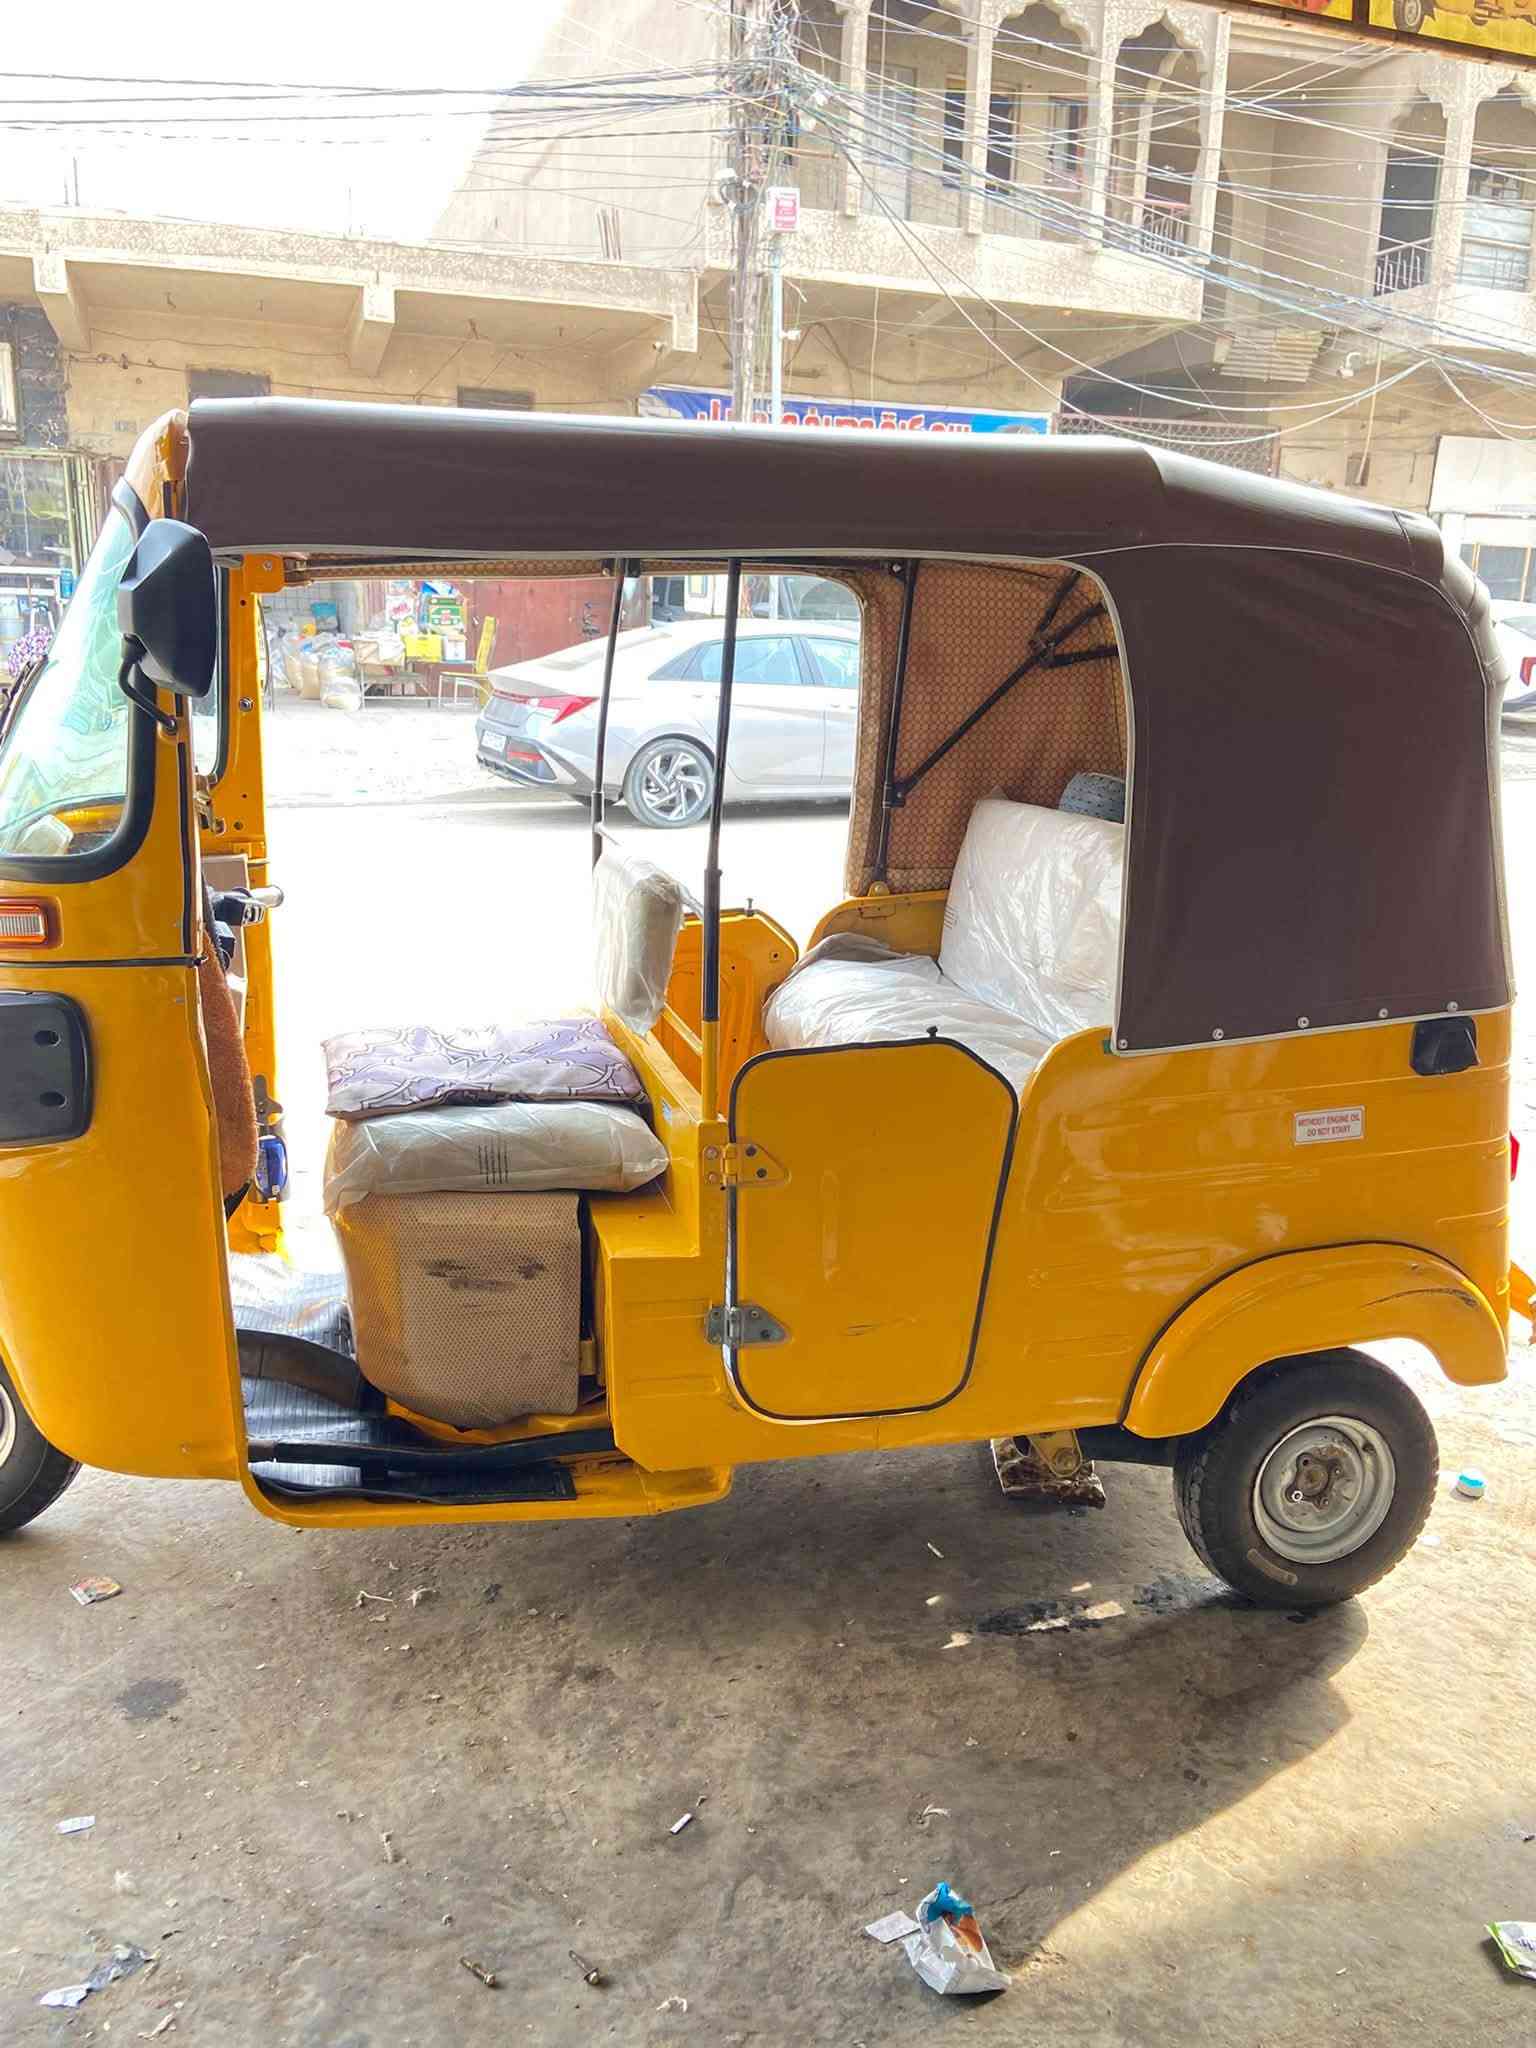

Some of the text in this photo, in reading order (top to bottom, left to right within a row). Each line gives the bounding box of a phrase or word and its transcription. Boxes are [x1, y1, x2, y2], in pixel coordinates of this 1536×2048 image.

[1298, 1112, 1360, 1126] WITHOUT ENGINE OIL
[1307, 1125, 1351, 1136] DO NOT START
